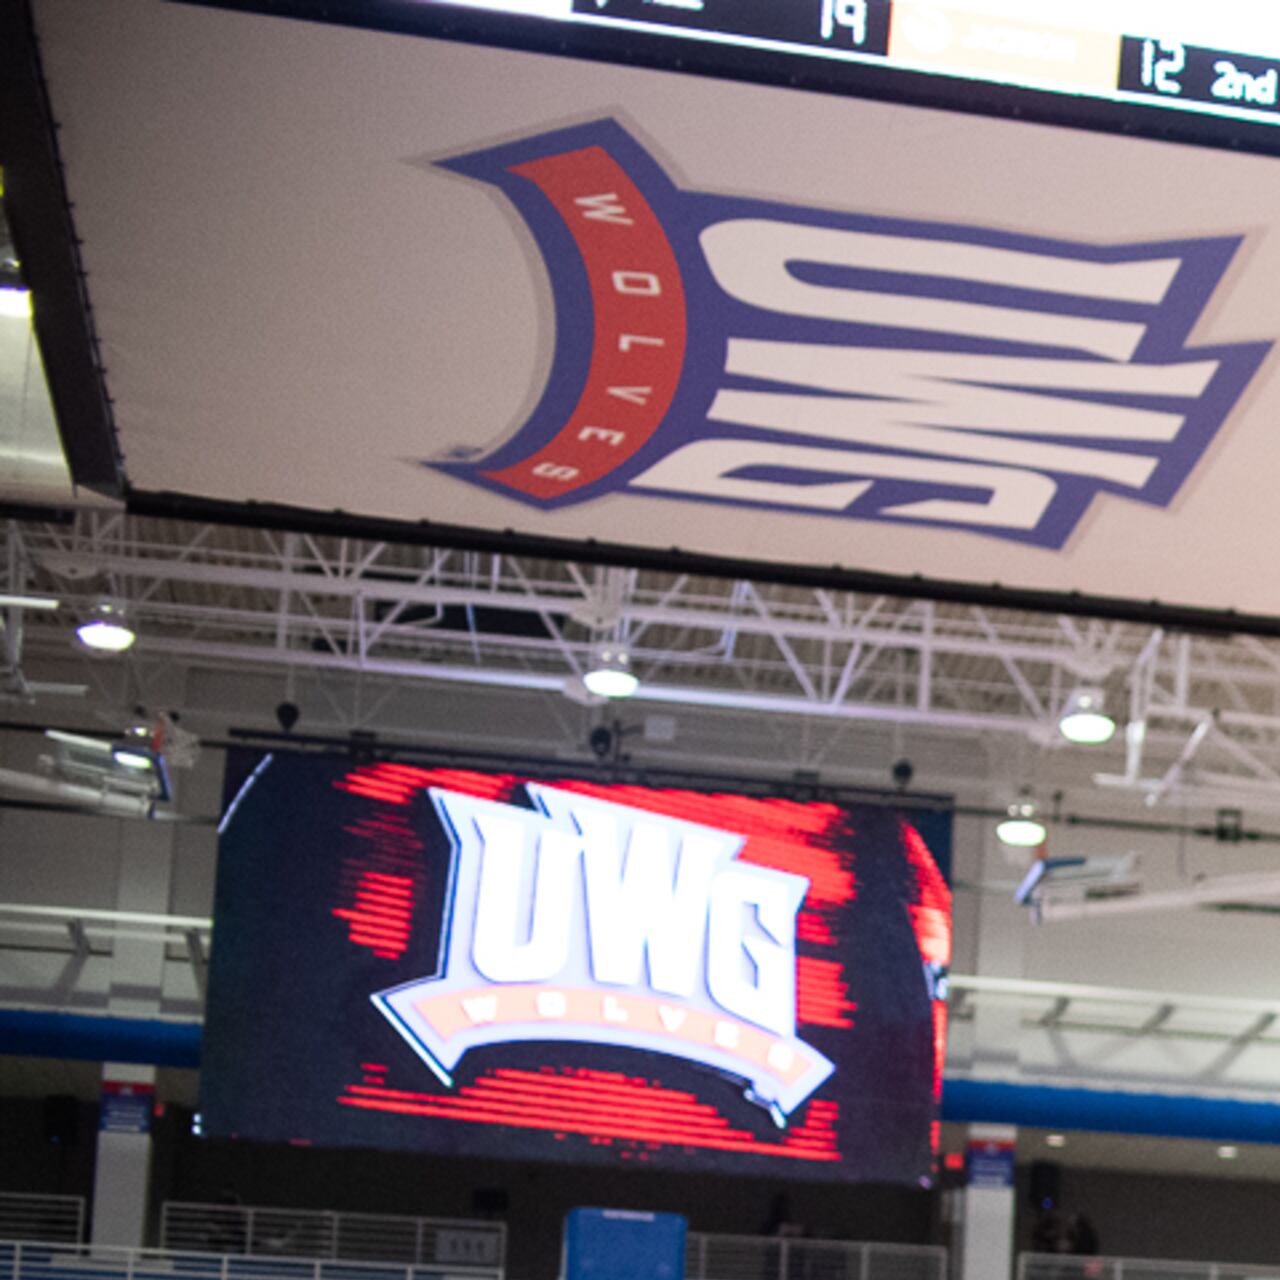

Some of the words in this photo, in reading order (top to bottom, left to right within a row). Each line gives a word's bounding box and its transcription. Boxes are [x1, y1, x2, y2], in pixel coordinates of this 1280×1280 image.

[1140, 38, 1186, 95] 12
[1210, 60, 1278, 106] 2nd
[532, 192, 671, 482] WOLVES
[629, 216, 1223, 530] UWG
[461, 991, 796, 1073] WOLVES
[465, 804, 801, 1035] UWG
